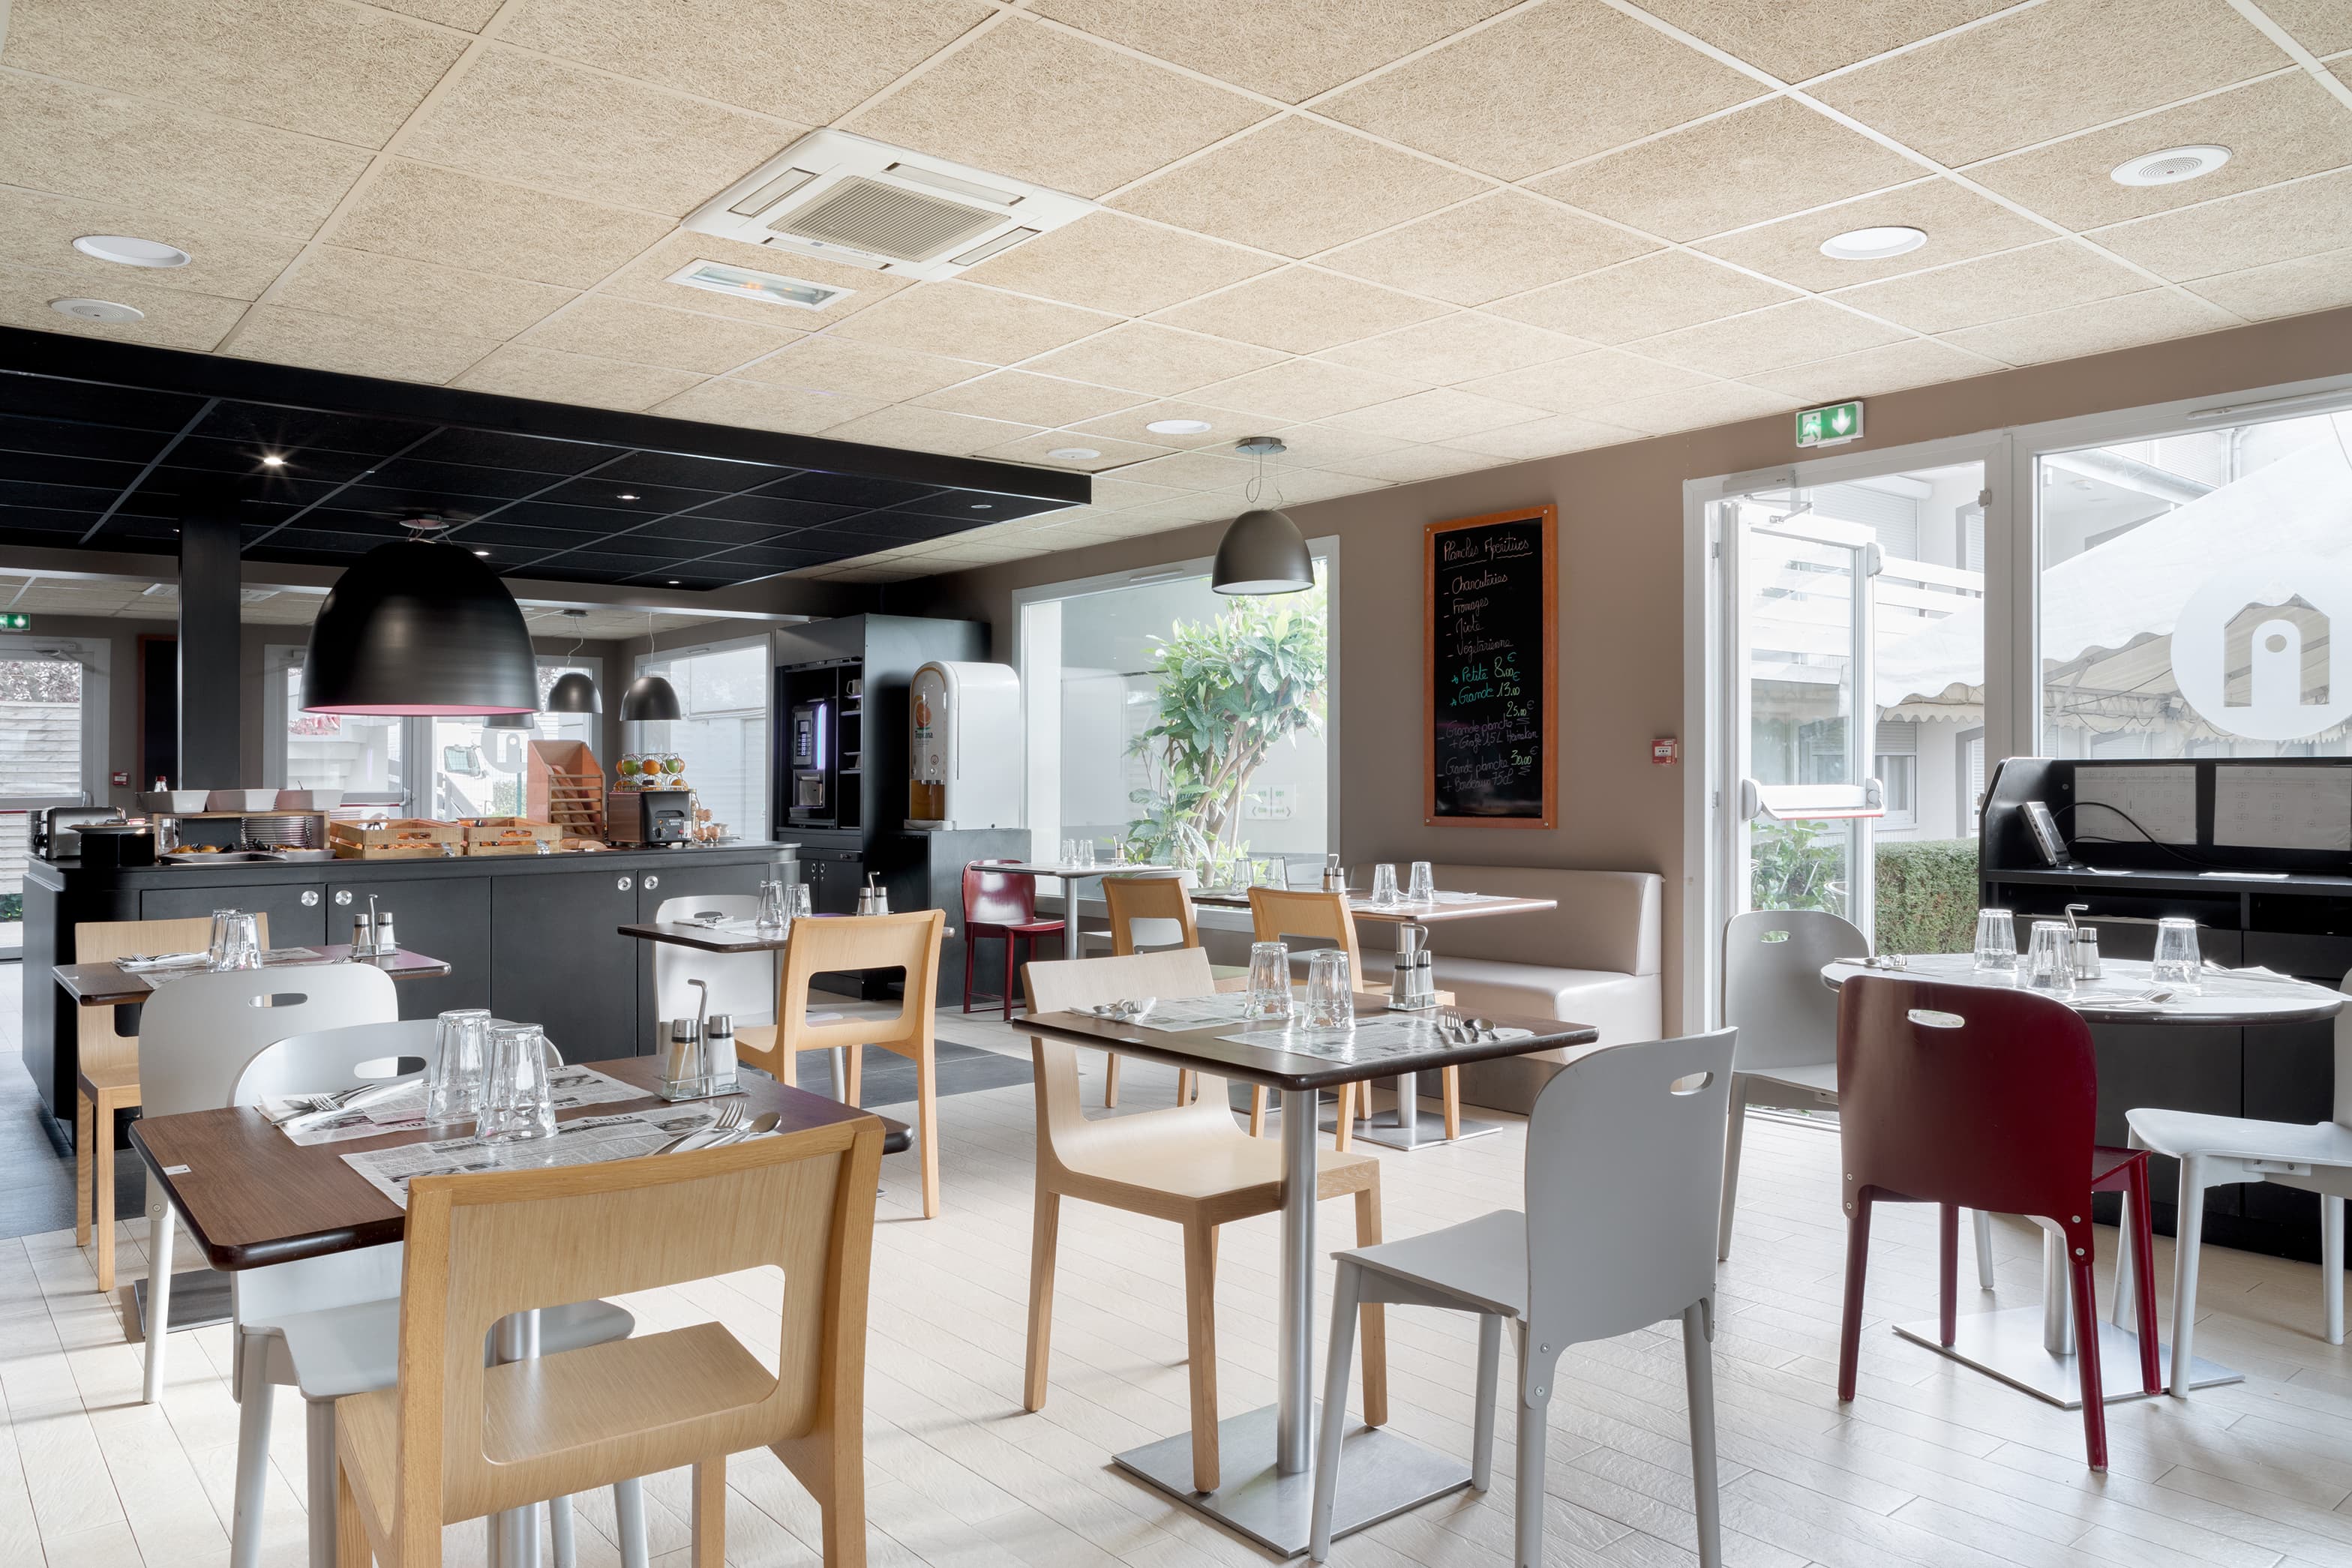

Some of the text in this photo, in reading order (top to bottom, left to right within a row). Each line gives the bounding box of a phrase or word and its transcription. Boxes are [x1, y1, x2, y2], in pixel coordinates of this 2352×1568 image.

[1444, 537, 1479, 562] Planches
[1453, 597, 1489, 616] Fromages
[1462, 662, 1489, 682] Petite
[1458, 682, 1495, 705] Grande
[1446, 720, 1479, 739] Grande
